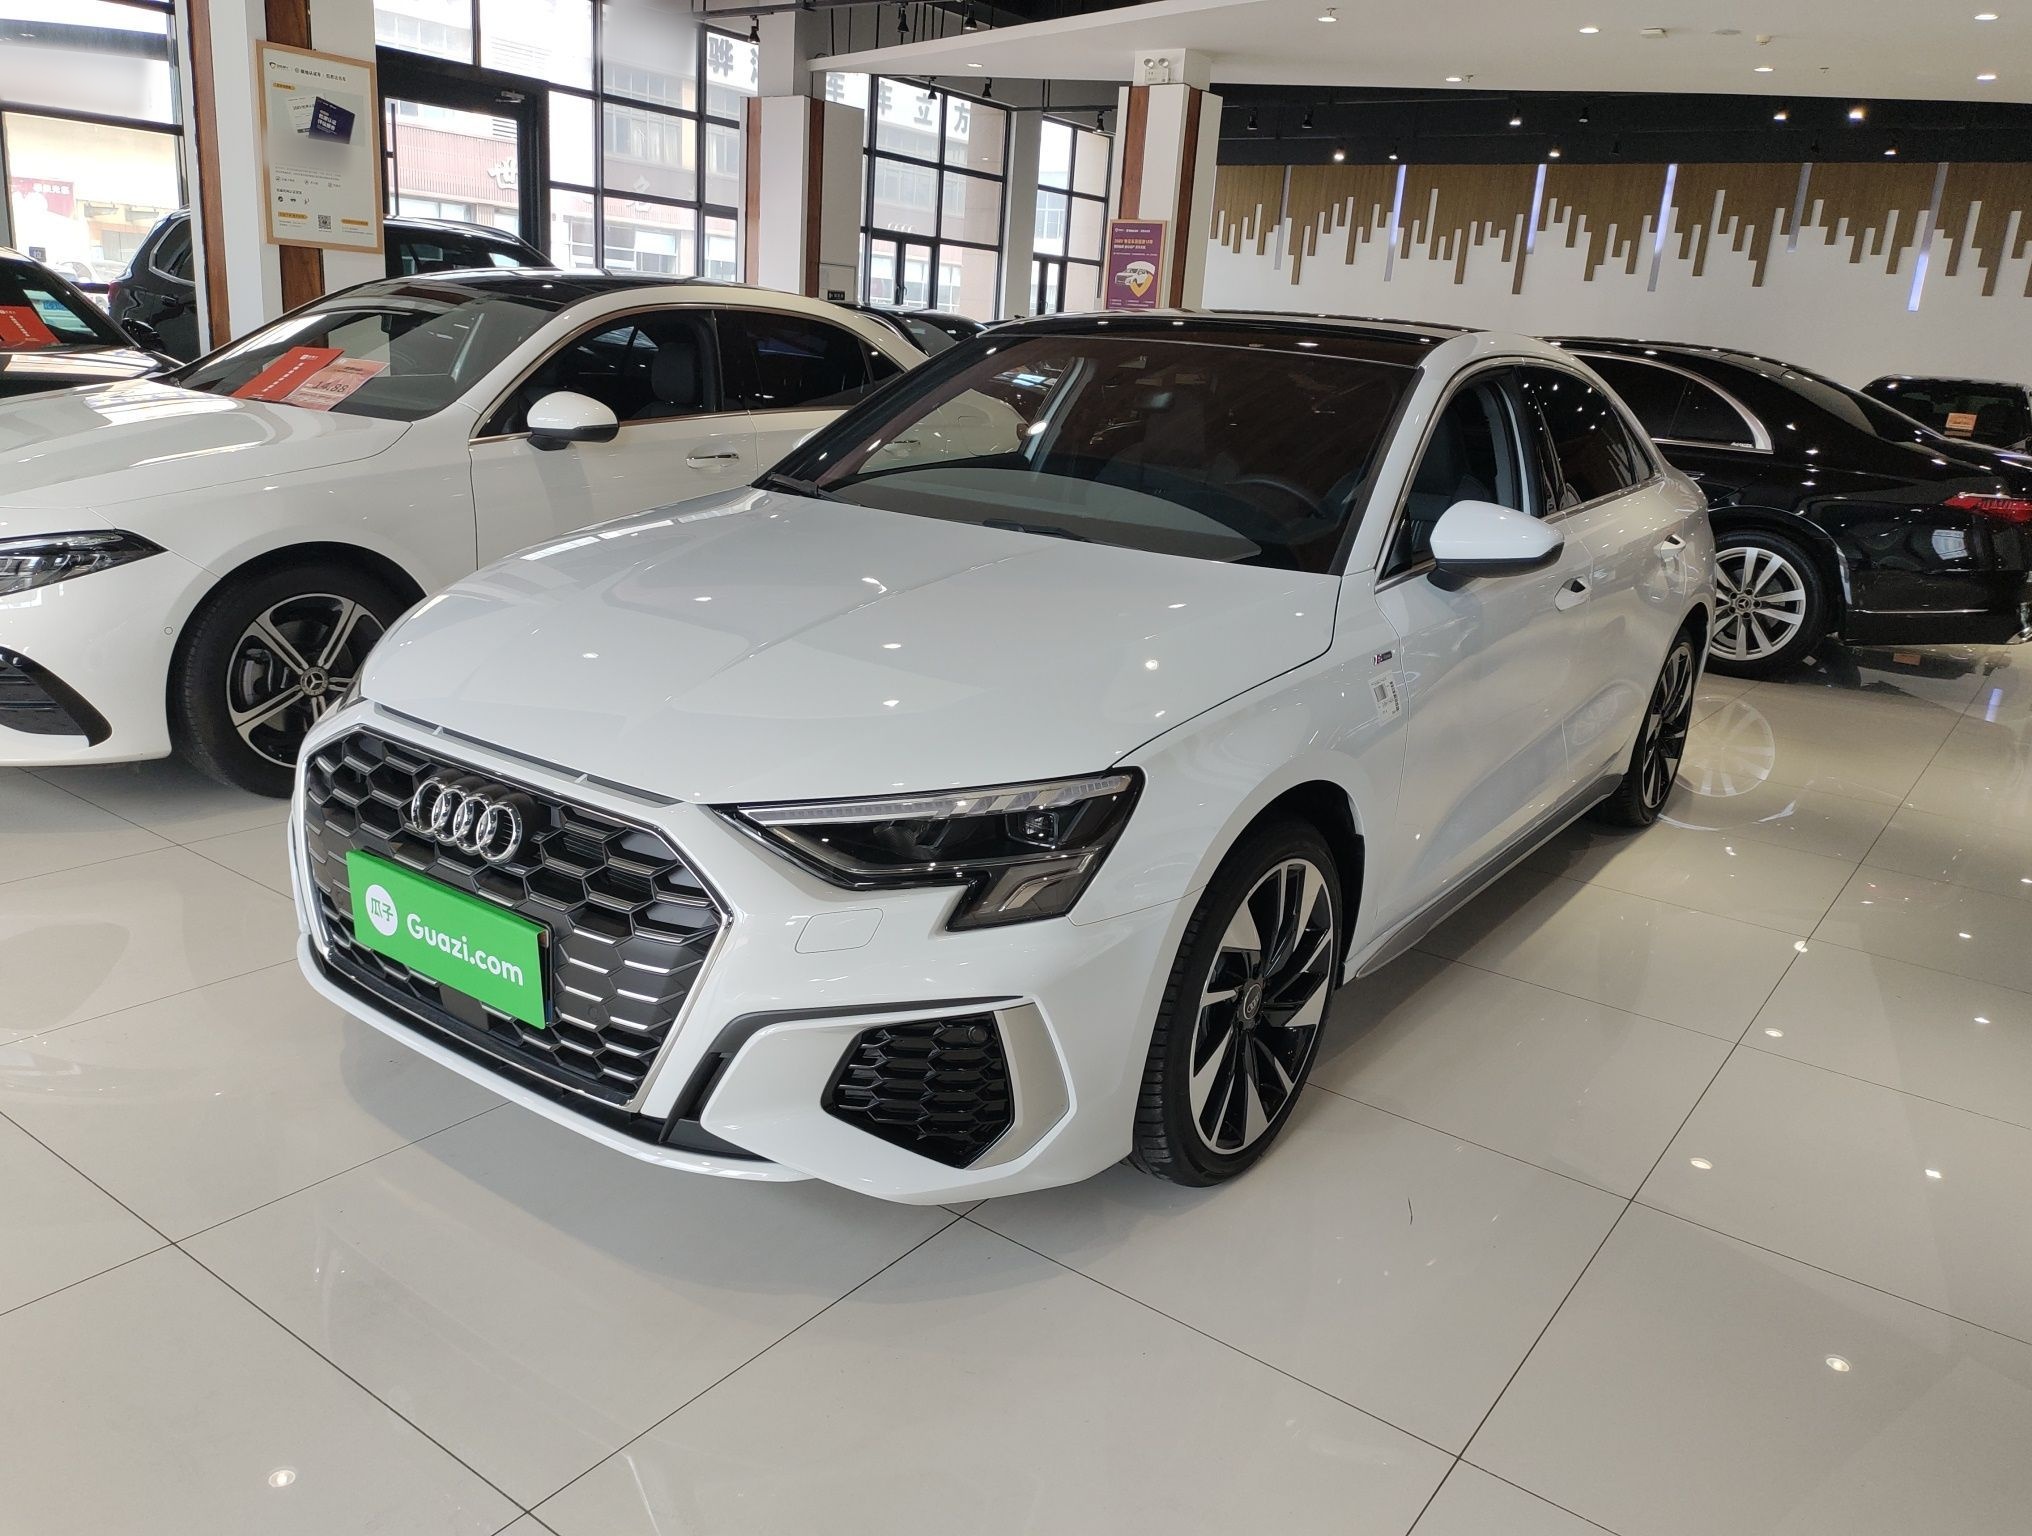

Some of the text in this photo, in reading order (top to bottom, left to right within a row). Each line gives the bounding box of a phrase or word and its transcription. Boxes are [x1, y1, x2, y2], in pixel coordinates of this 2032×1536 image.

[312, 380, 350, 393] 14.88
[371, 898, 524, 987] 瓜子 Guazi.com
